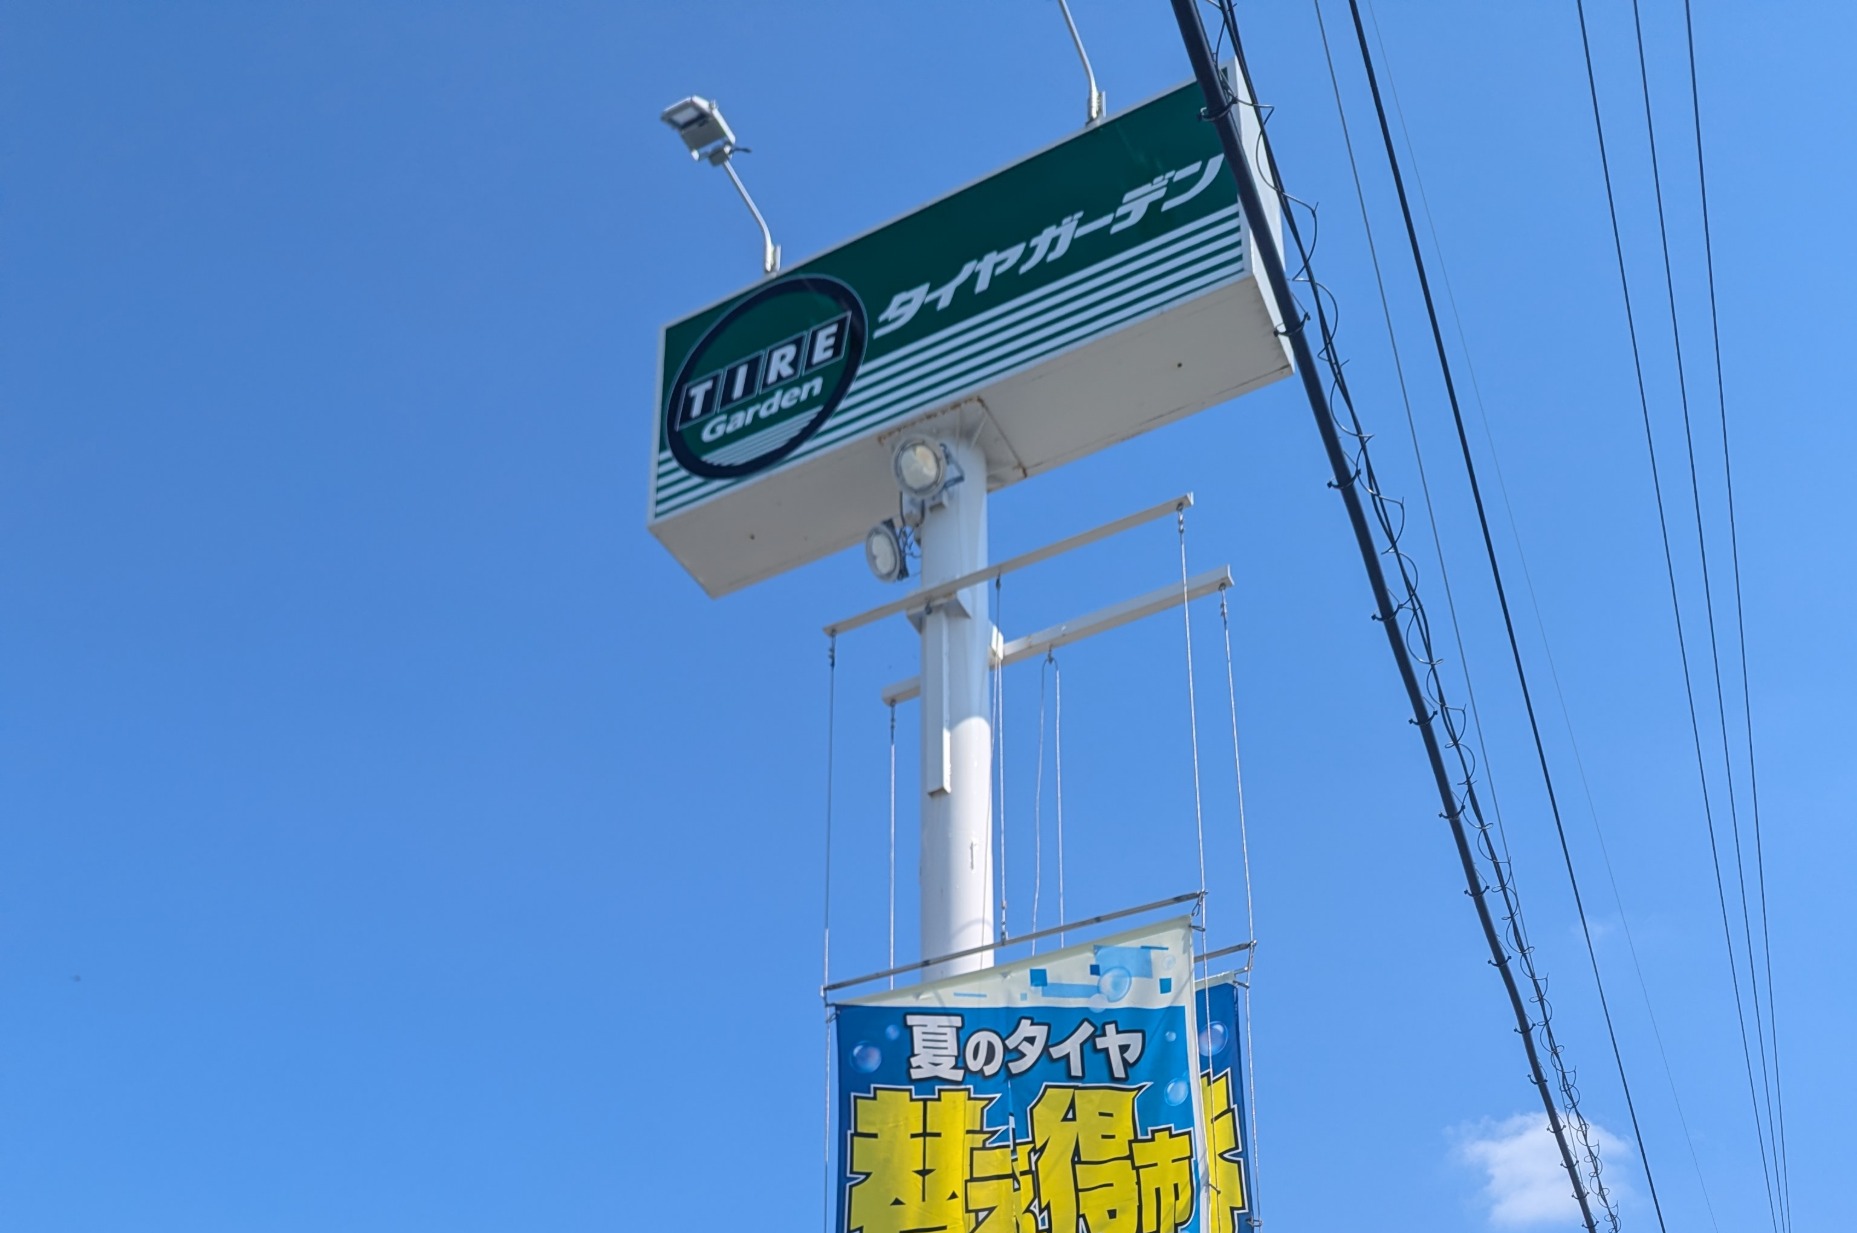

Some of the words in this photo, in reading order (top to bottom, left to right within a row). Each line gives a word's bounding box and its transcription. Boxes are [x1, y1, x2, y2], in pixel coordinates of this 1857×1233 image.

[873, 153, 1225, 339] タイヤガーデン
[687, 320, 843, 419] TIRE
[700, 377, 823, 444] Garden
[905, 1014, 1144, 1081] 夏のタイヤ
